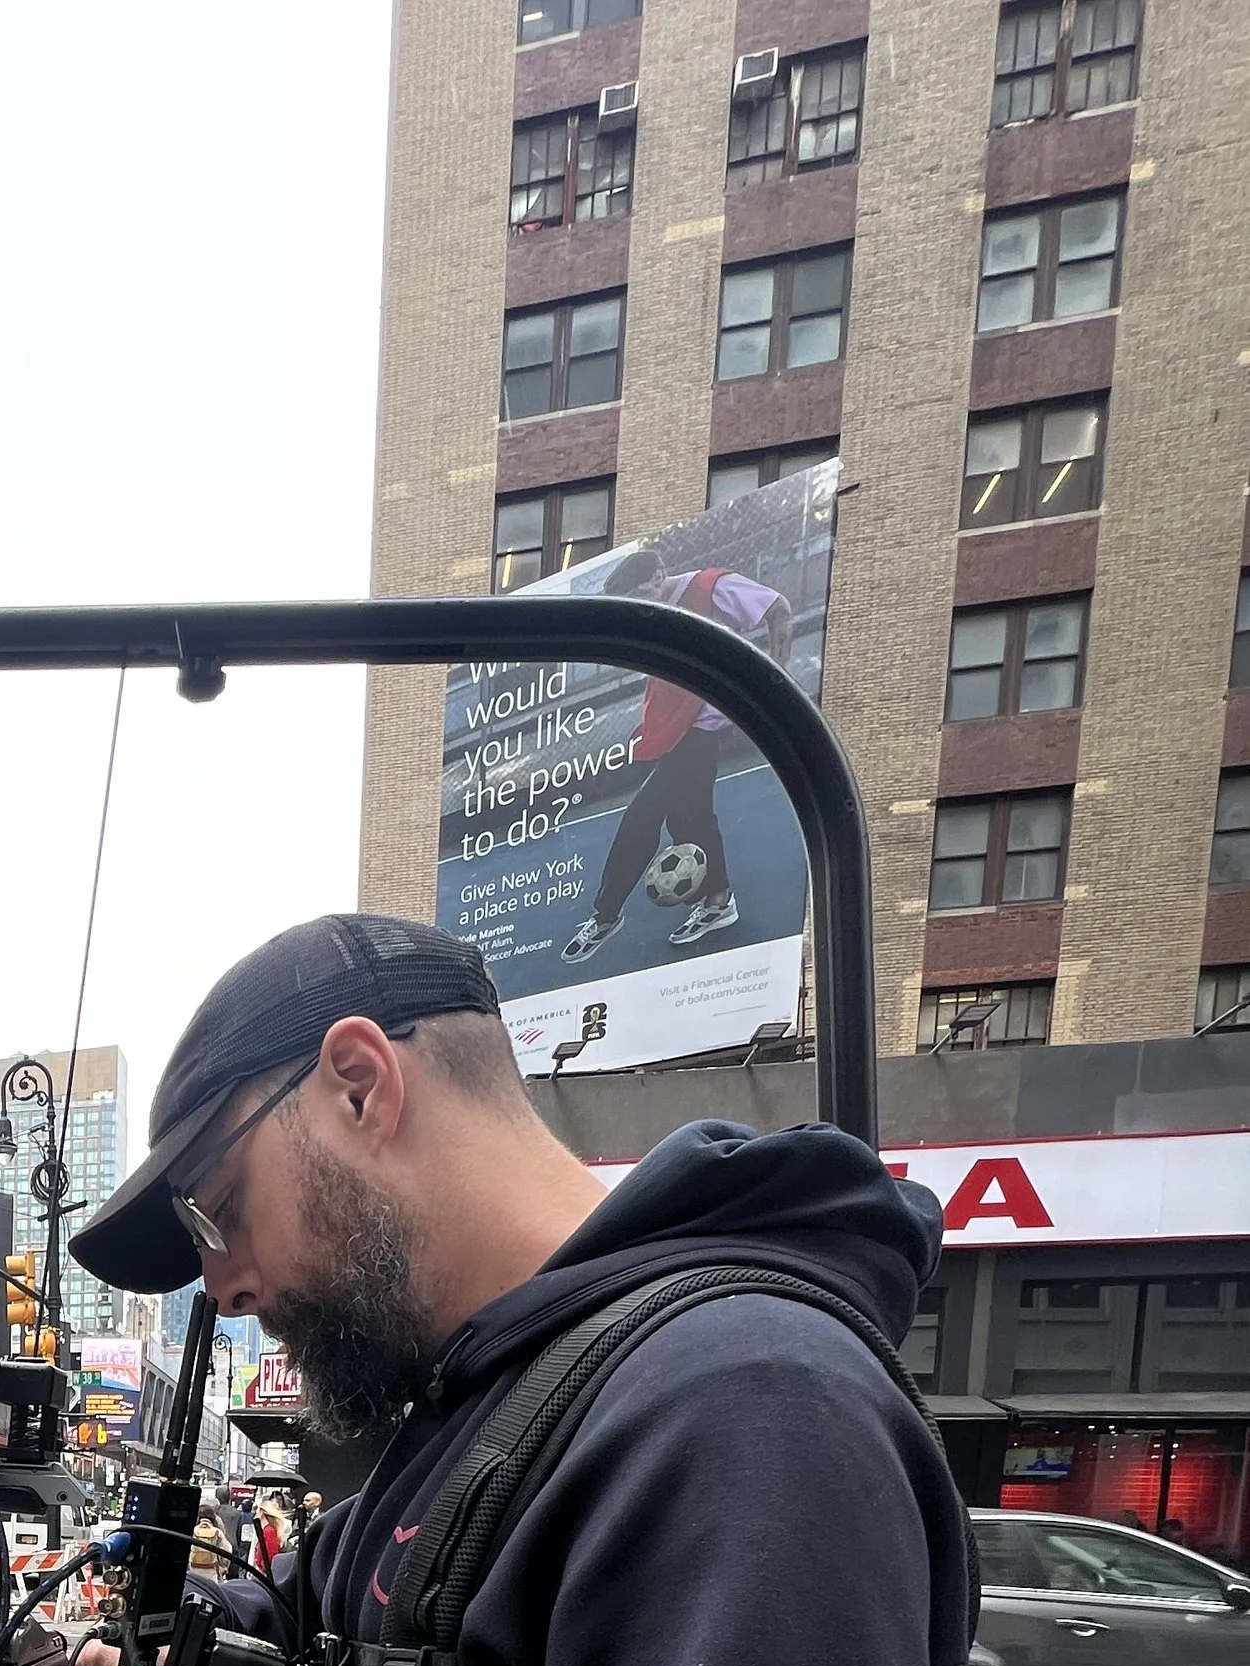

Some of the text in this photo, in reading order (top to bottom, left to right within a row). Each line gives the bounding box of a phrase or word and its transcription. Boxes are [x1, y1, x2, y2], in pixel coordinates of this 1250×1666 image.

[465, 661, 567, 729] would
[462, 706, 595, 785] you like
[463, 735, 643, 817] the power
[461, 831, 494, 861] to
[460, 853, 584, 903] Give New York
[459, 879, 585, 926] a place to play.
[479, 924, 515, 941] Martino
[484, 939, 553, 964] Soccer Advocate
[660, 966, 770, 997] Visit a Financial Center
[675, 981, 769, 1008] or bofa.com/soccer
[516, 1018, 527, 1027] OF
[530, 1008, 572, 1024] AMERICA
[73, 1372, 80, 1384] W
[82, 1372, 92, 1384] 38
